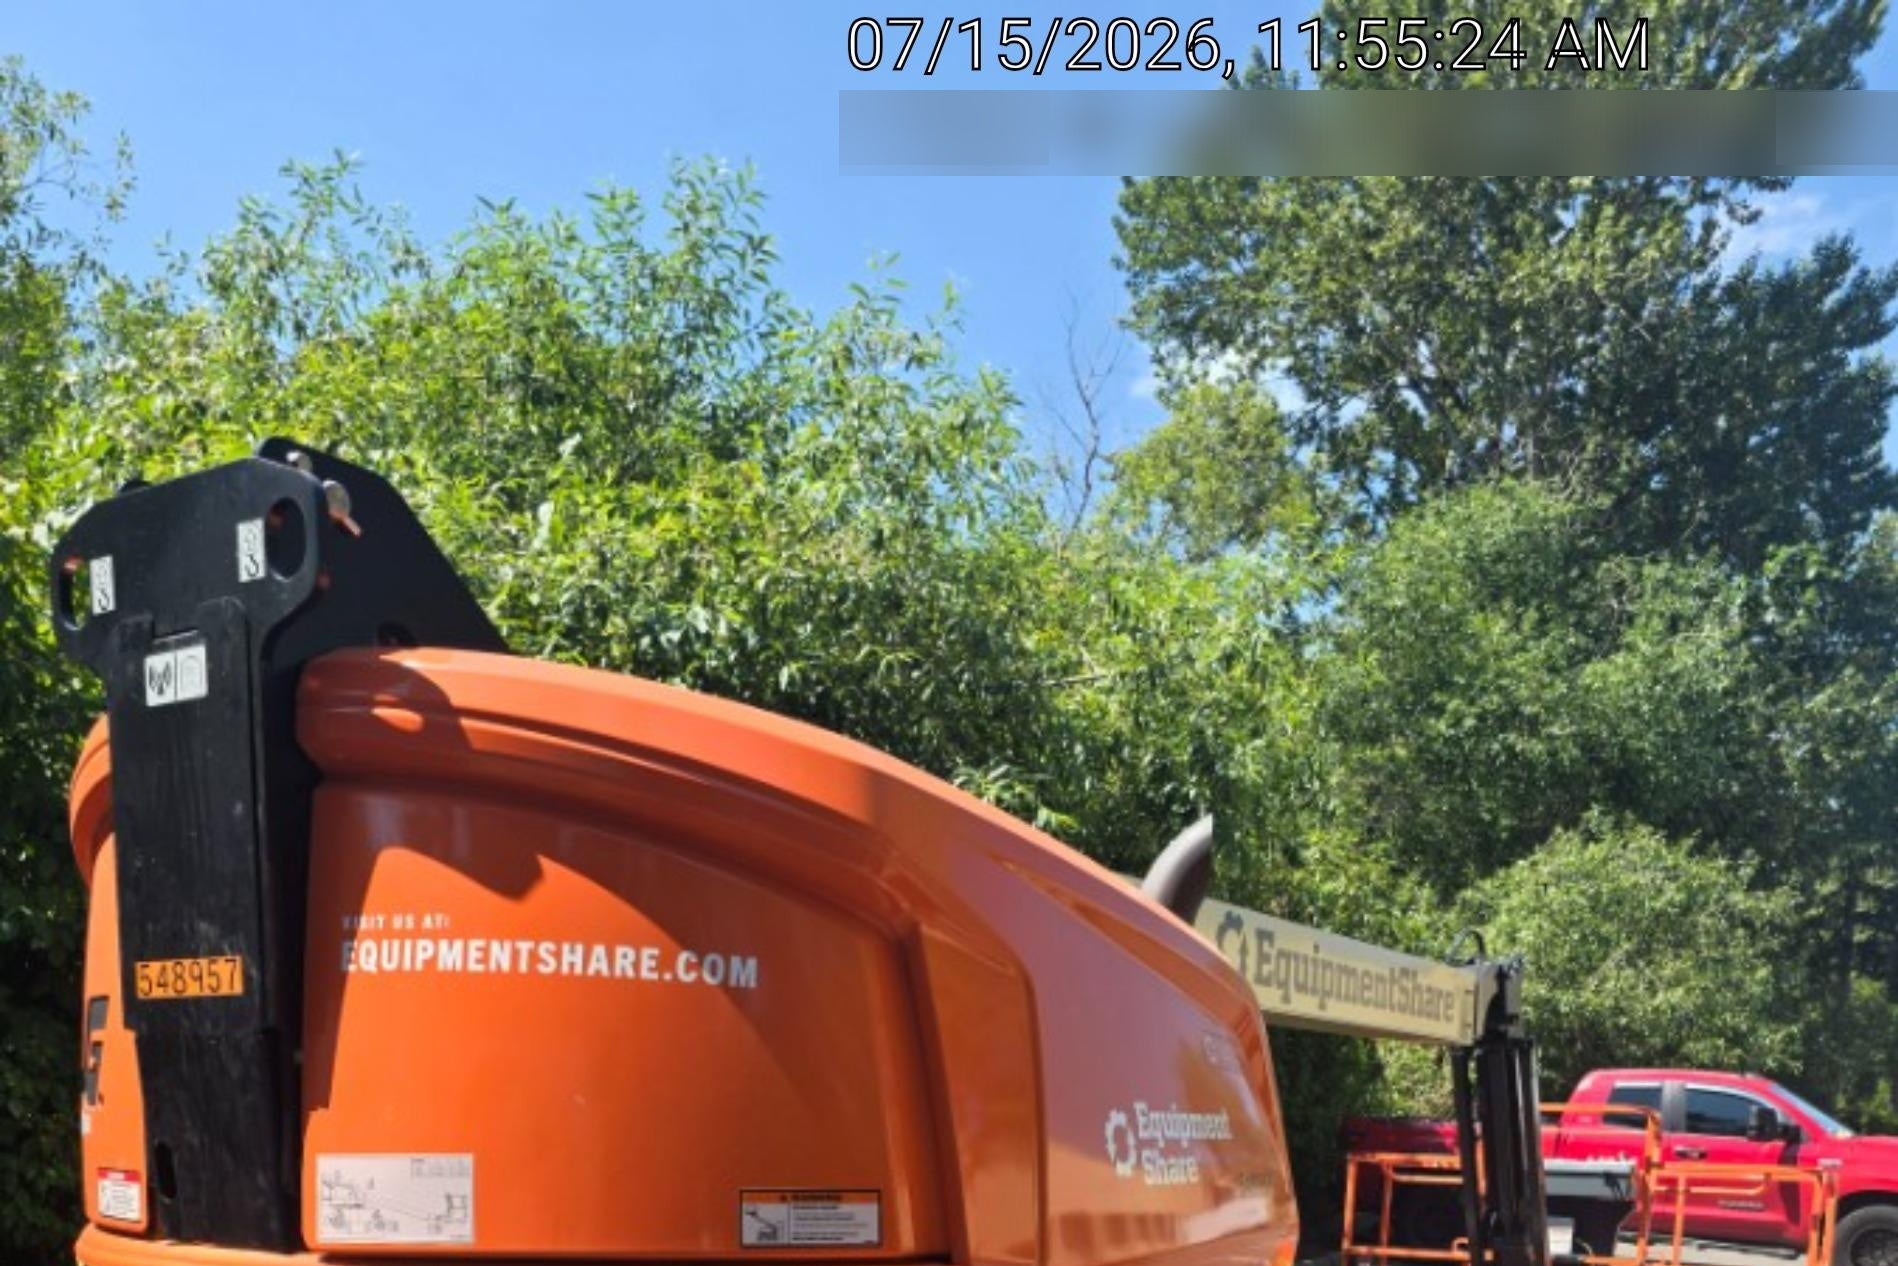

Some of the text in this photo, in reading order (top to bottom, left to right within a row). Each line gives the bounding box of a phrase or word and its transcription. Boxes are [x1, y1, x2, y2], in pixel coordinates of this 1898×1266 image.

[392, 912, 415, 930] US
[138, 958, 238, 997] 548957
[341, 937, 759, 989] EQUIPMENTSHARE.COM
[1254, 927, 1455, 1024] EquipmentShare
[1133, 1102, 1233, 1148] Equipment
[1140, 1149, 1200, 1186] Share
